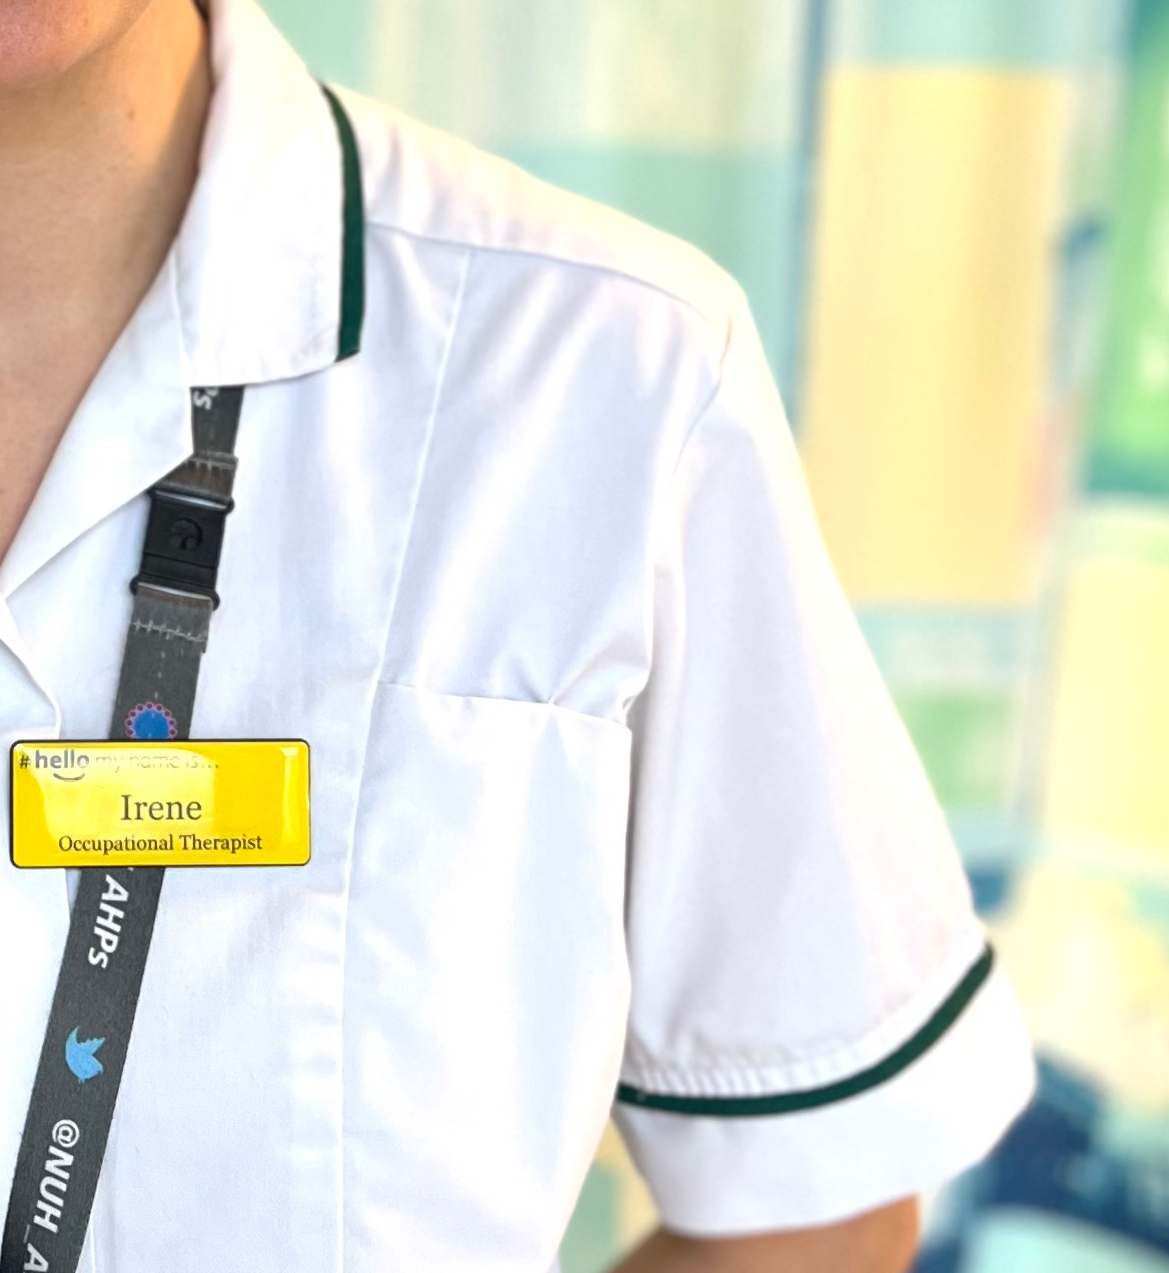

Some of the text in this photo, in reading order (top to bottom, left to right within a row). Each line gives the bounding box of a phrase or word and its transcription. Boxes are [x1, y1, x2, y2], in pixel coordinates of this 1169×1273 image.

[120, 793, 202, 821] Irene
[59, 833, 263, 855] Occupational Therapist
[88, 873, 130, 969] AHPs
